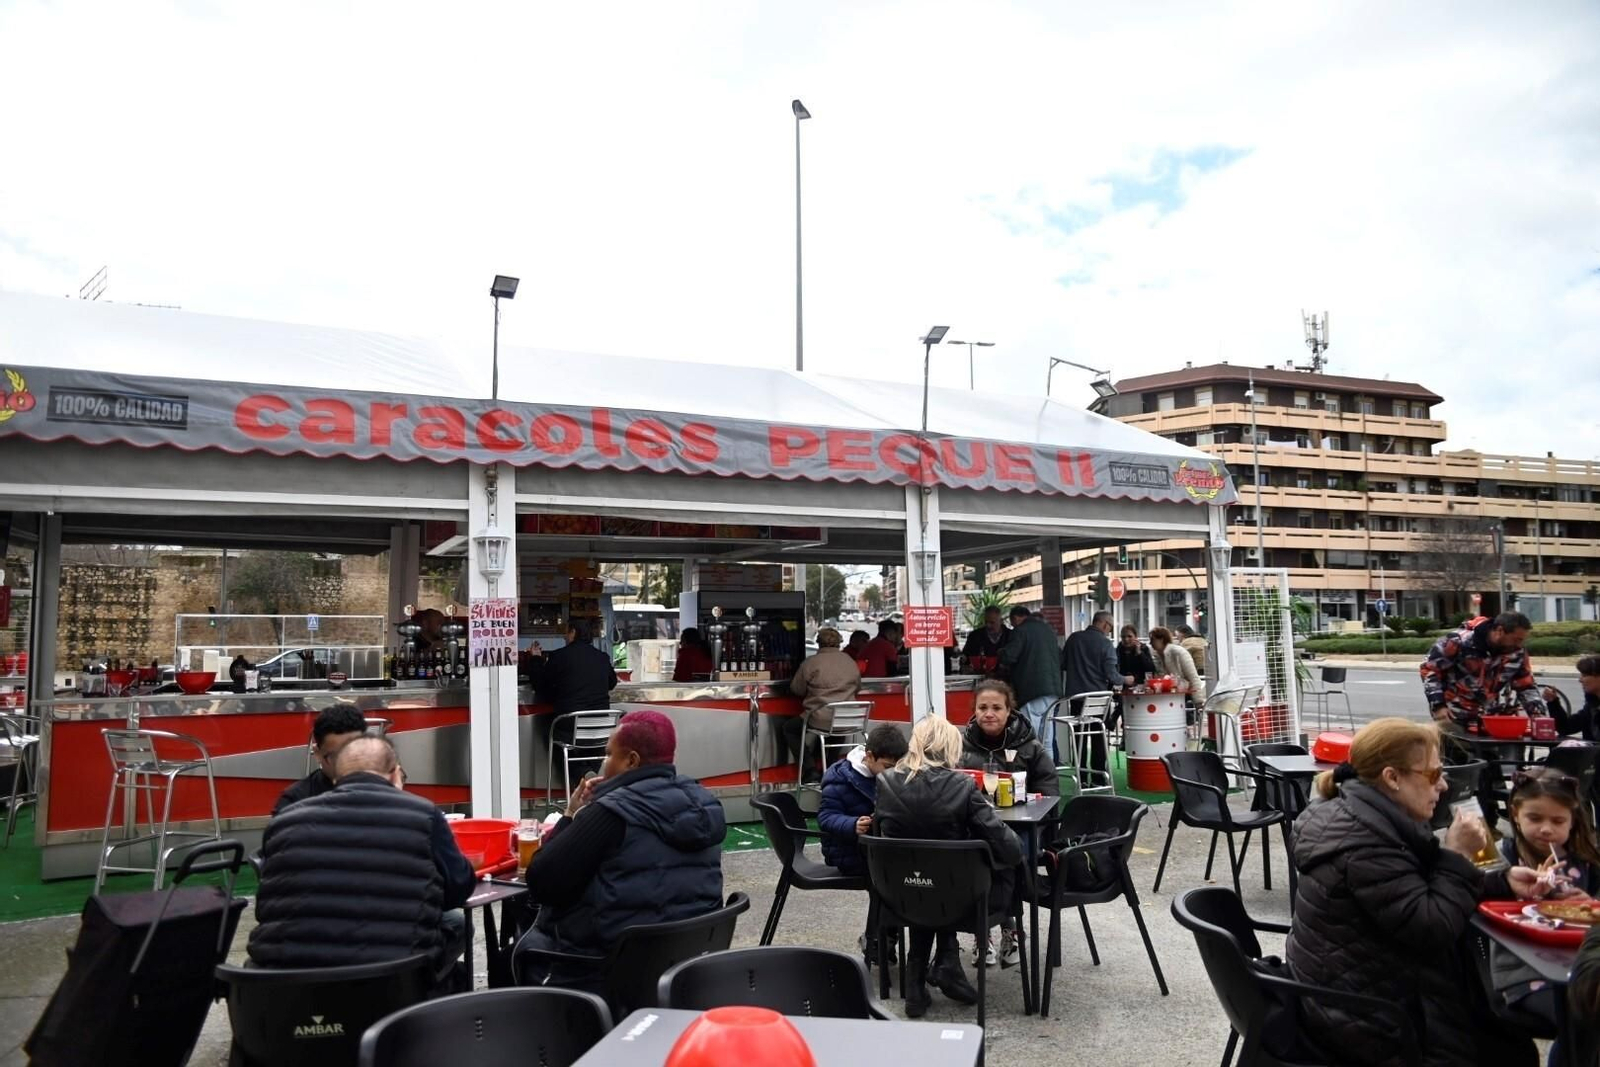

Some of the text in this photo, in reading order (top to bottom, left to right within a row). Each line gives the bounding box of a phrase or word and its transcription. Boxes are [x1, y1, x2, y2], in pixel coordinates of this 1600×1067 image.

[54, 395, 110, 417] 100%
[115, 399, 183, 421] CALIDAD
[232, 393, 720, 463] caracoles
[768, 426, 1037, 483] PEQUE
[1112, 467, 1137, 482] 100%
[472, 620, 515, 628] DE BUEN
[472, 629, 514, 638] ROLLO
[474, 647, 513, 667] PASAR
[904, 877, 934, 886] AMBAR
[294, 1023, 344, 1036] AMBAR
